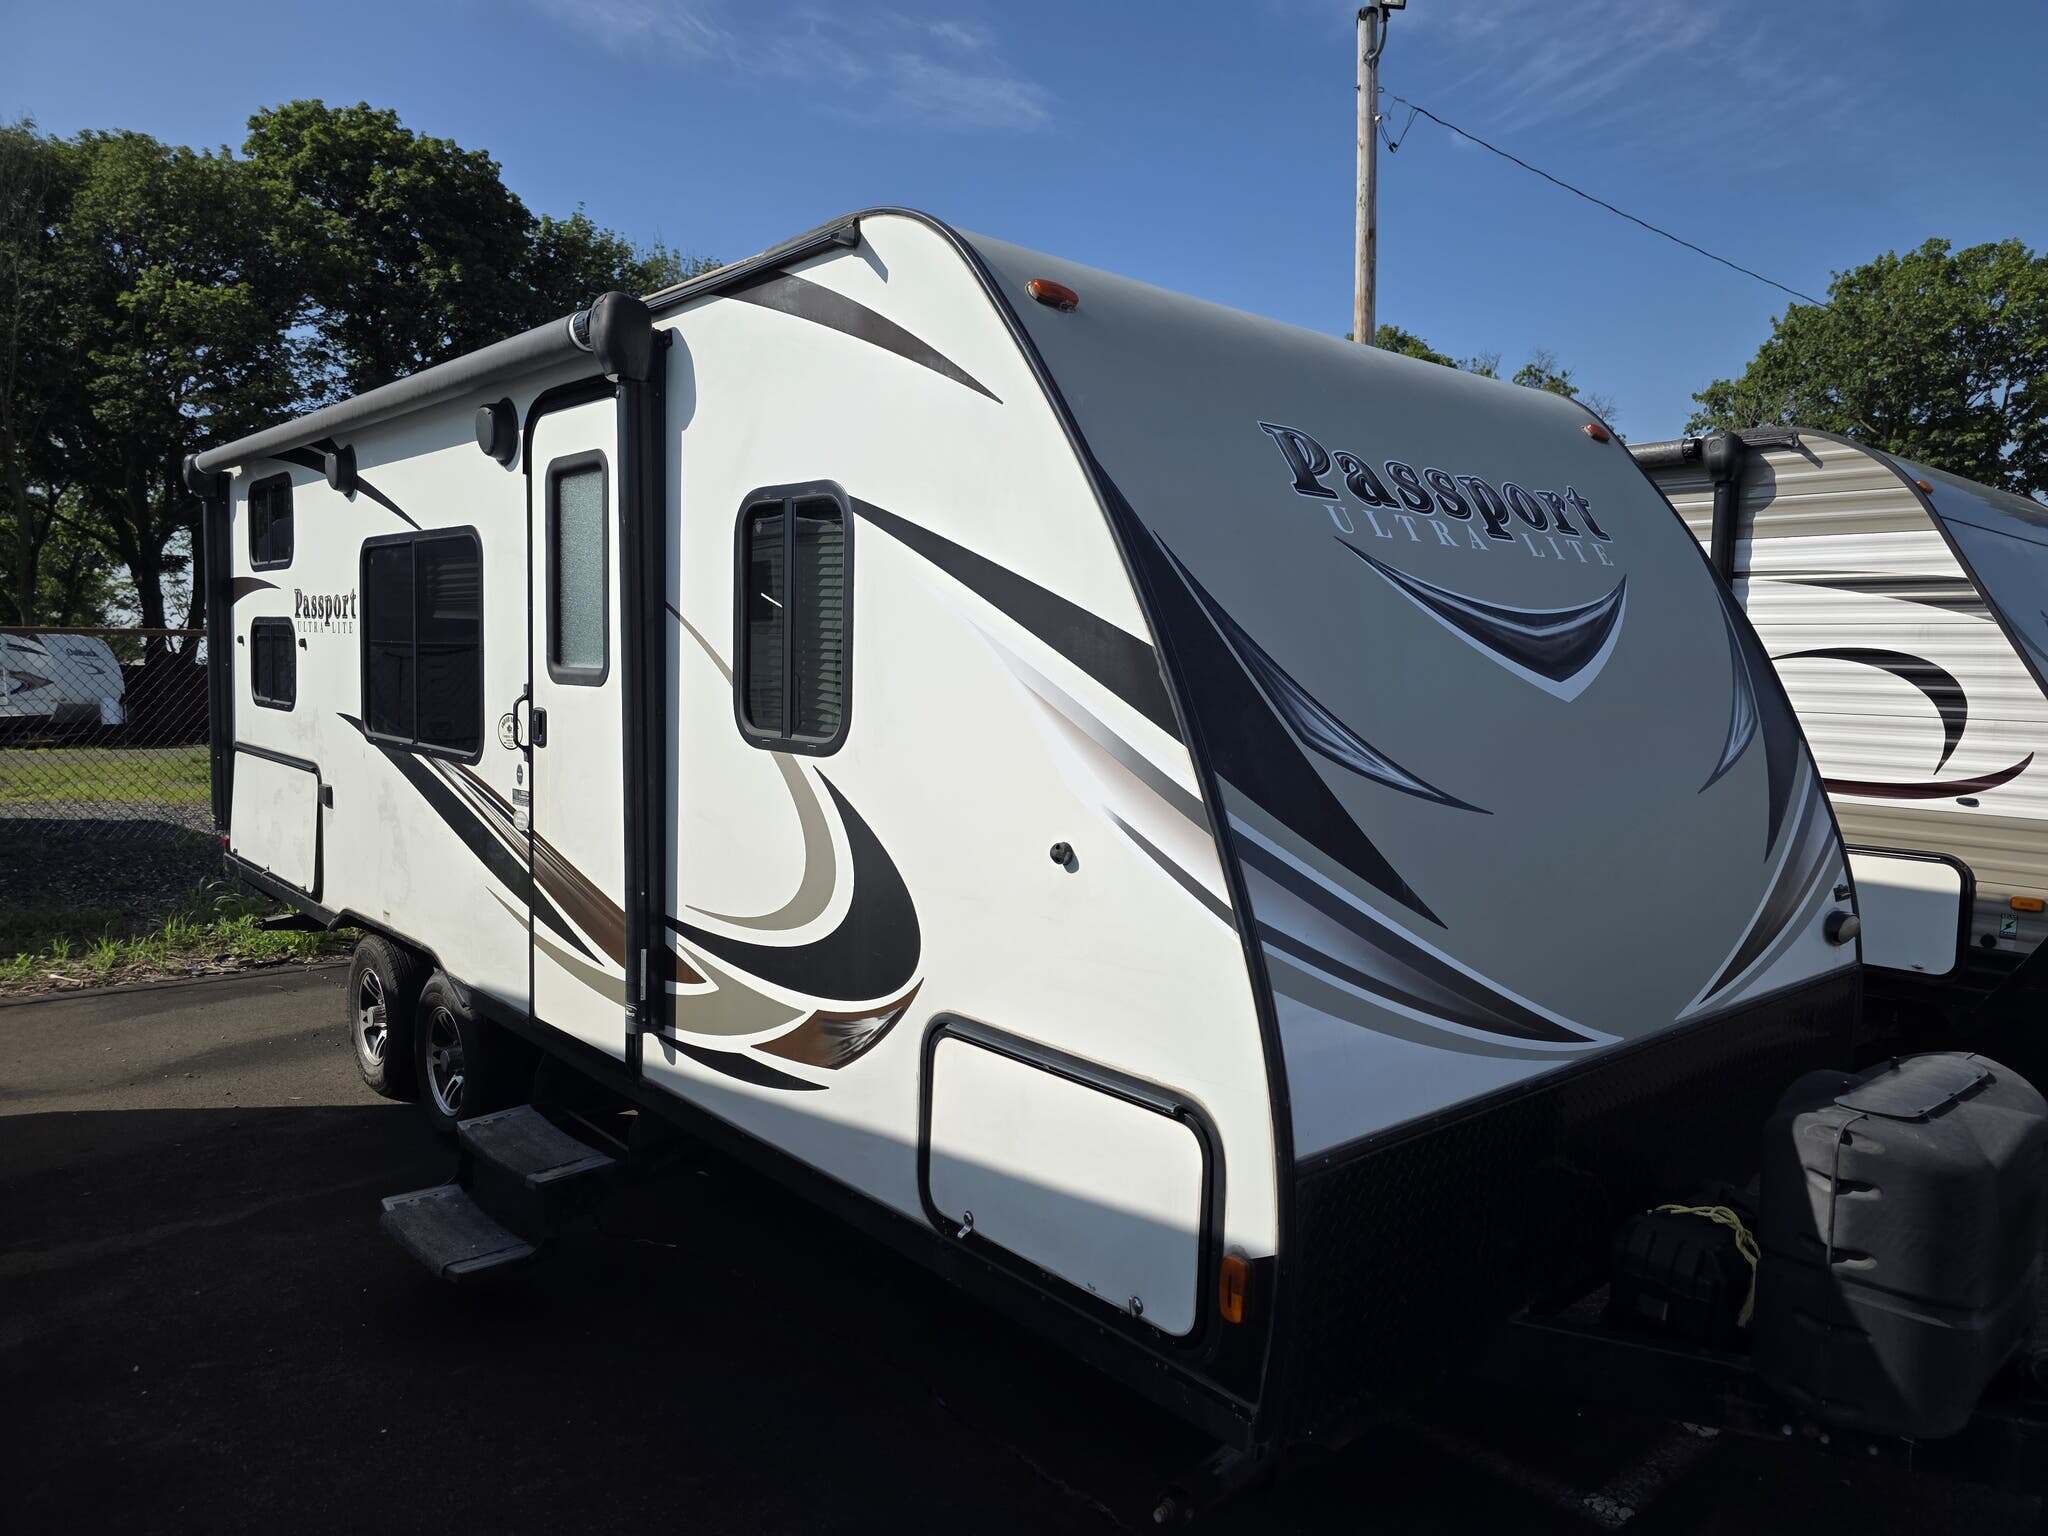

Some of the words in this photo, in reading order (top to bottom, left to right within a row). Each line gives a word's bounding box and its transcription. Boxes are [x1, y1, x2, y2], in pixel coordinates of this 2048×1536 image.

[1257, 420, 1613, 543] Passport
[1324, 504, 1490, 551] ULTRA
[1521, 533, 1614, 566] LITE
[294, 588, 357, 627] Passport
[297, 621, 324, 633] ULTRA
[332, 622, 353, 634] LITE
